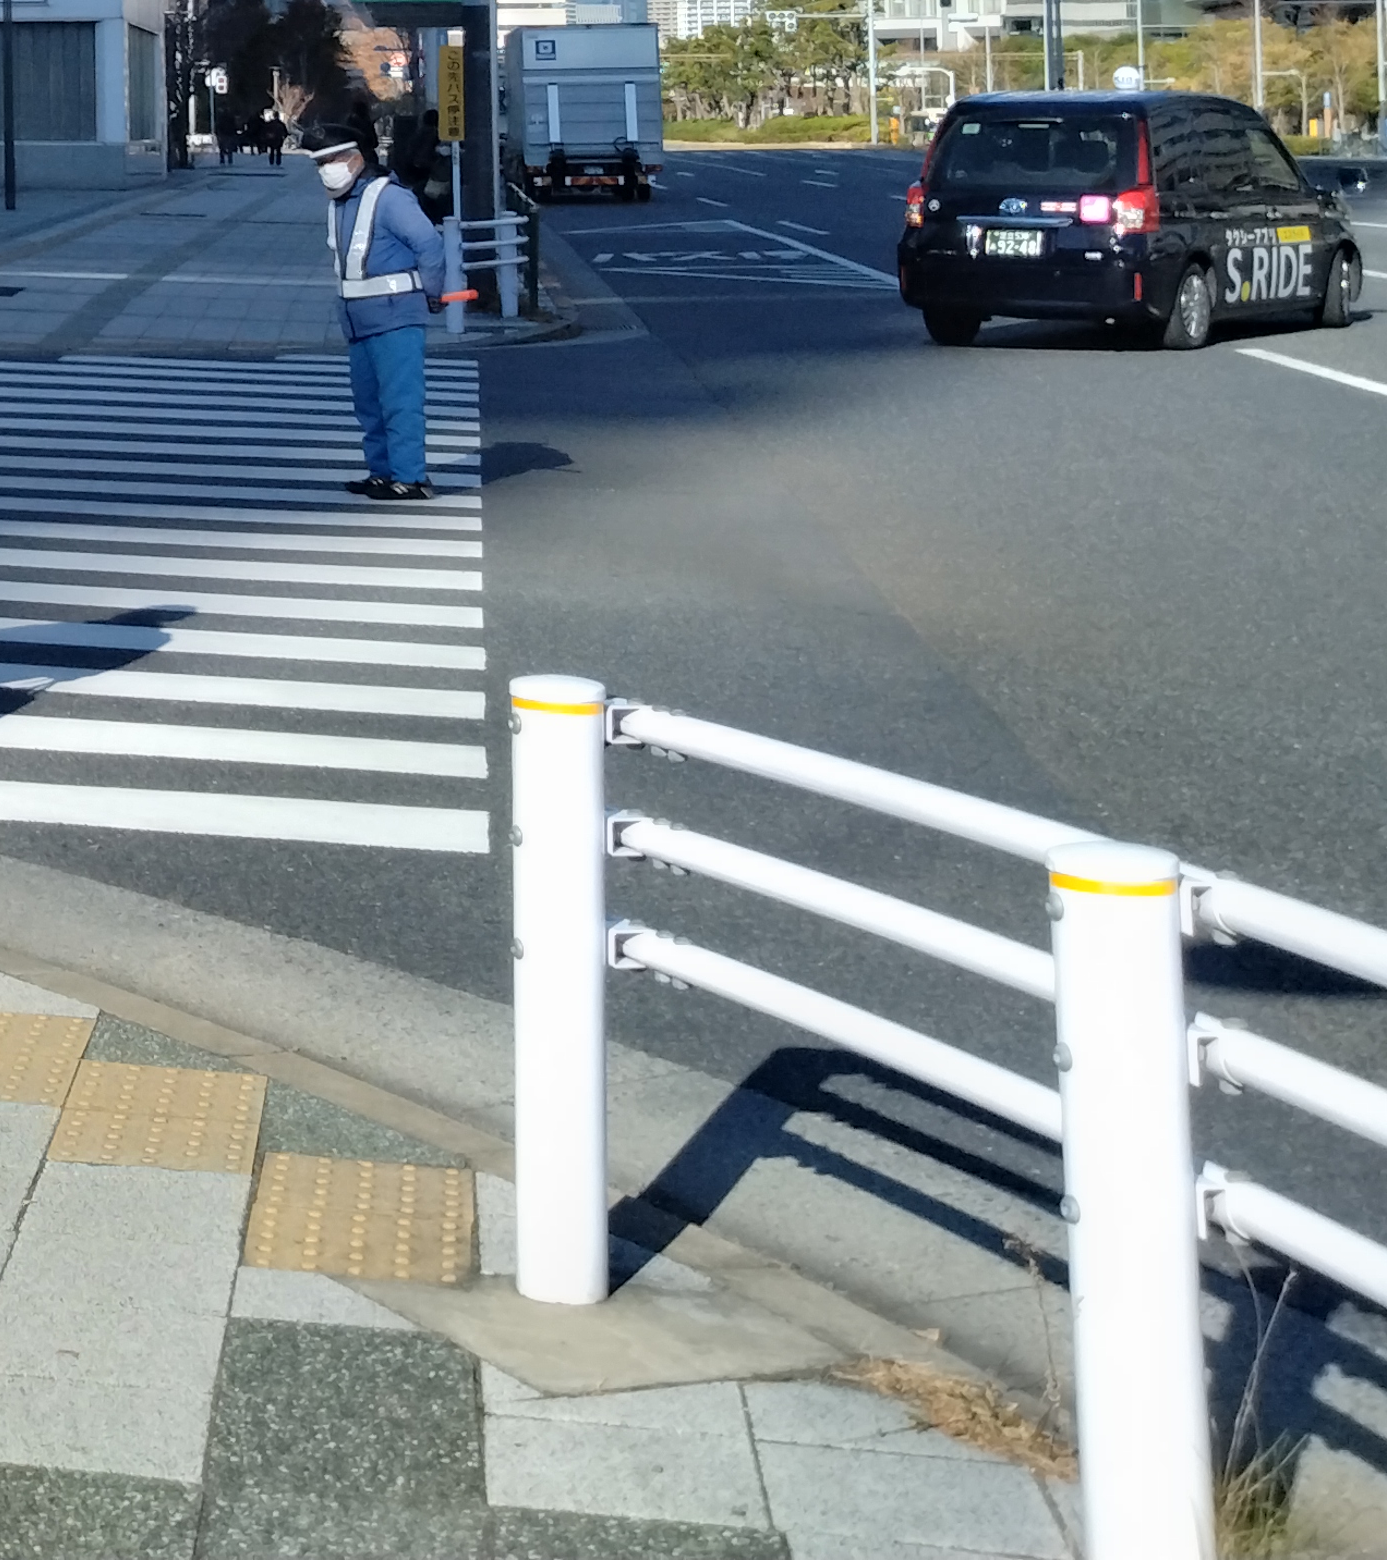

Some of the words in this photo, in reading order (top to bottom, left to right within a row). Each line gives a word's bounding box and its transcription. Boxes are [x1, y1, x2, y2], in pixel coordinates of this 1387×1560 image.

[1225, 226, 1278, 247] タクシーアプリ
[1224, 244, 1313, 304] S.RIDE
